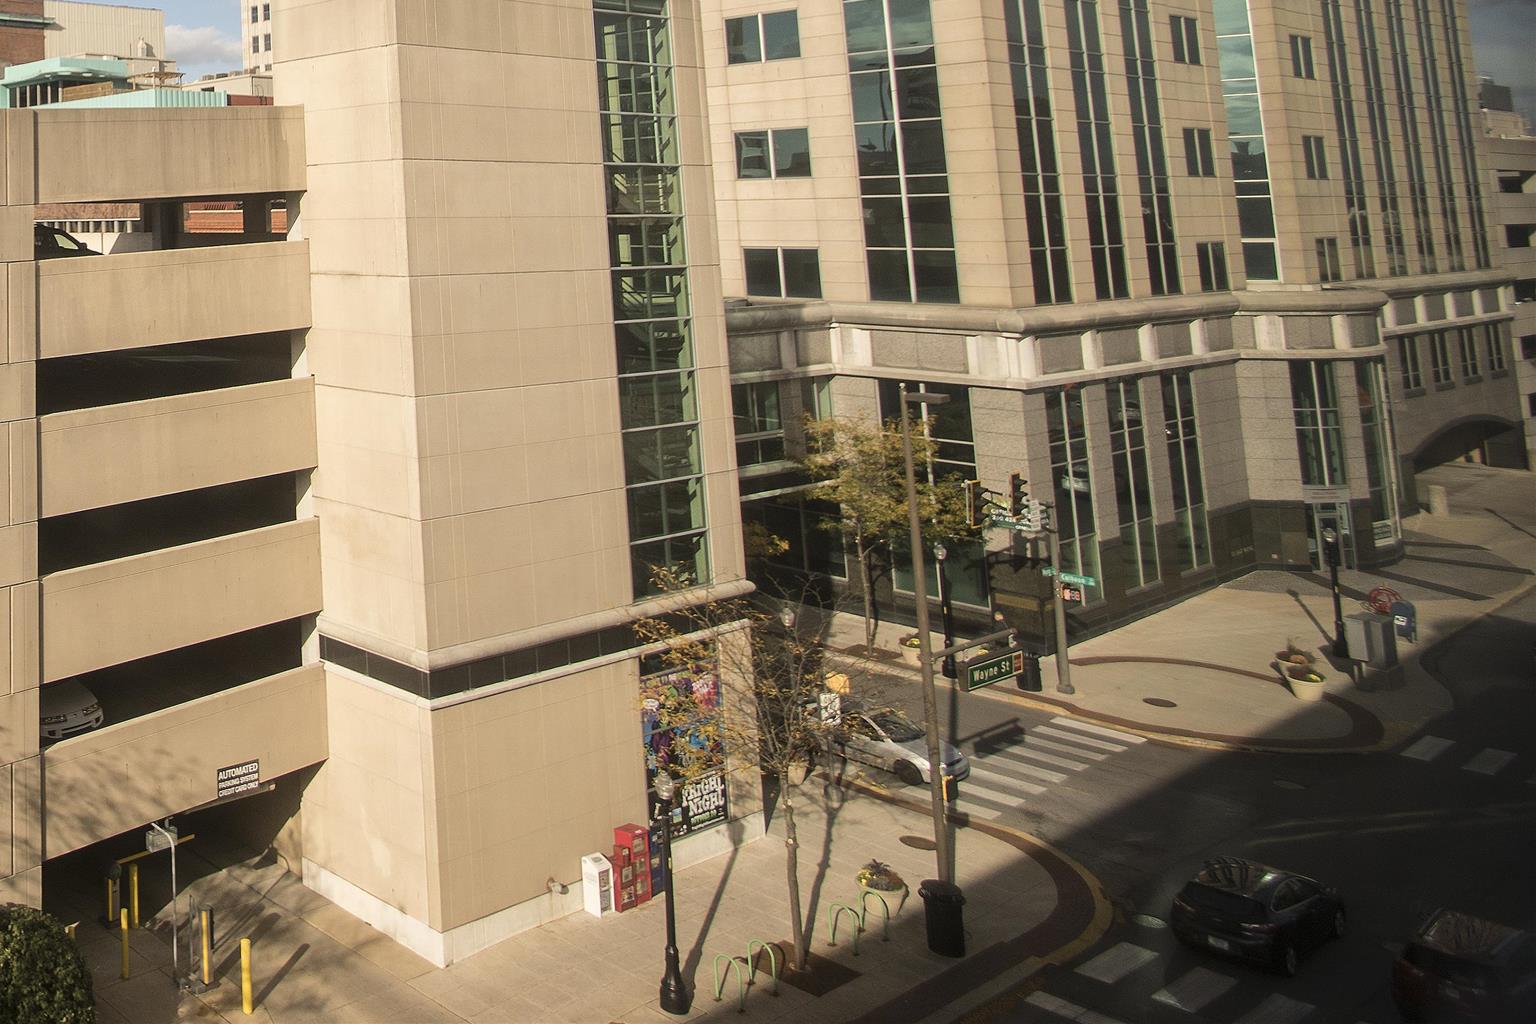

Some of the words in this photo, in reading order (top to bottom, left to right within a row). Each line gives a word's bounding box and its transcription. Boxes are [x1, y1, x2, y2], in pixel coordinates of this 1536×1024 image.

[973, 666, 998, 681] Wayne
[1001, 661, 1010, 672] St
[218, 763, 258, 781] AUTOMATED
[219, 778, 240, 789] PARKING
[240, 773, 258, 783] SYSTEM
[219, 787, 234, 797] CREDIT
[235, 784, 247, 793] CARD
[247, 780, 259, 789] ONLY
[689, 790, 725, 816] NIGHT
